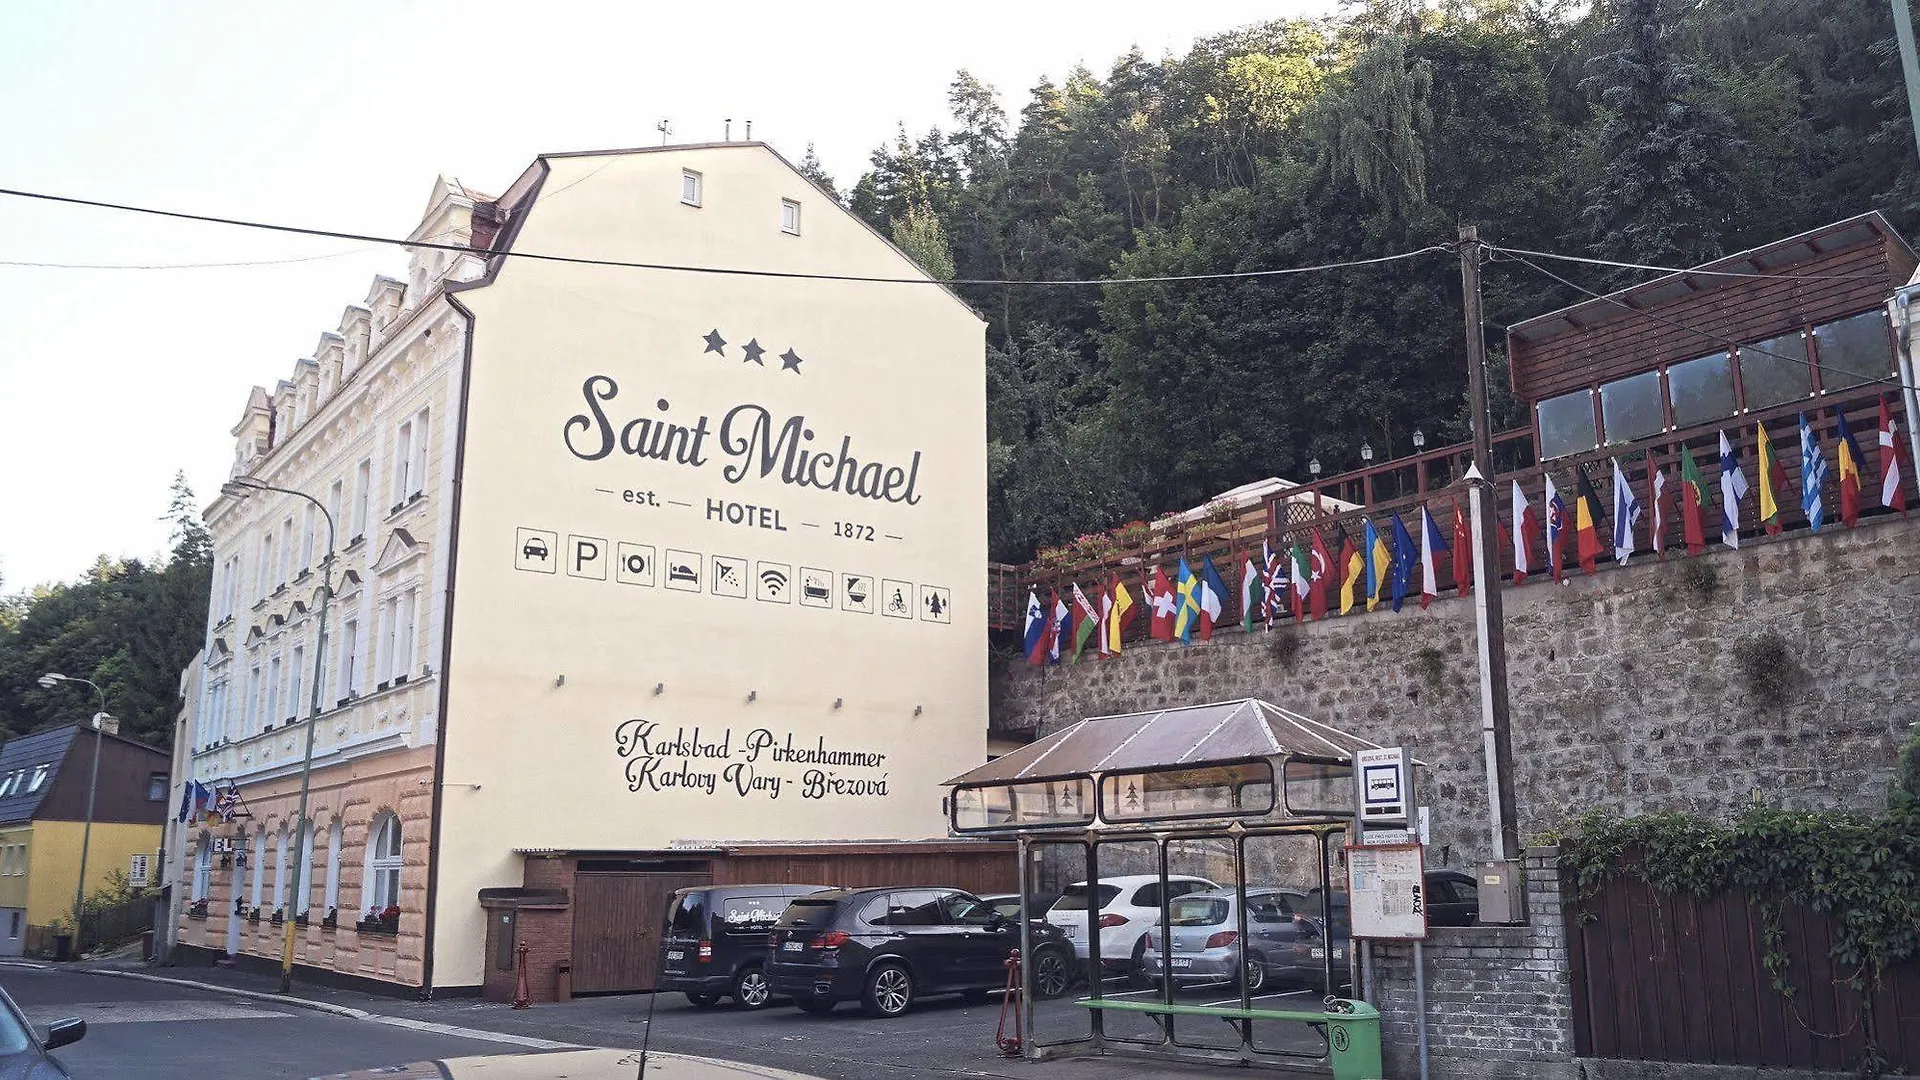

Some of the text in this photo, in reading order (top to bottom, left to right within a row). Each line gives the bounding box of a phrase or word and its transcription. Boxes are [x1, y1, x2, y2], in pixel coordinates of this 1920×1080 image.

[564, 375, 921, 506] Saint Michael
[623, 487, 875, 542] est. HOTEL 1872
[576, 541, 599, 571] P
[615, 719, 731, 758] Karlsbad
[625, 755, 717, 795] Karlovy
[722, 762, 781, 799] Vary
[802, 769, 889, 799] Březová
